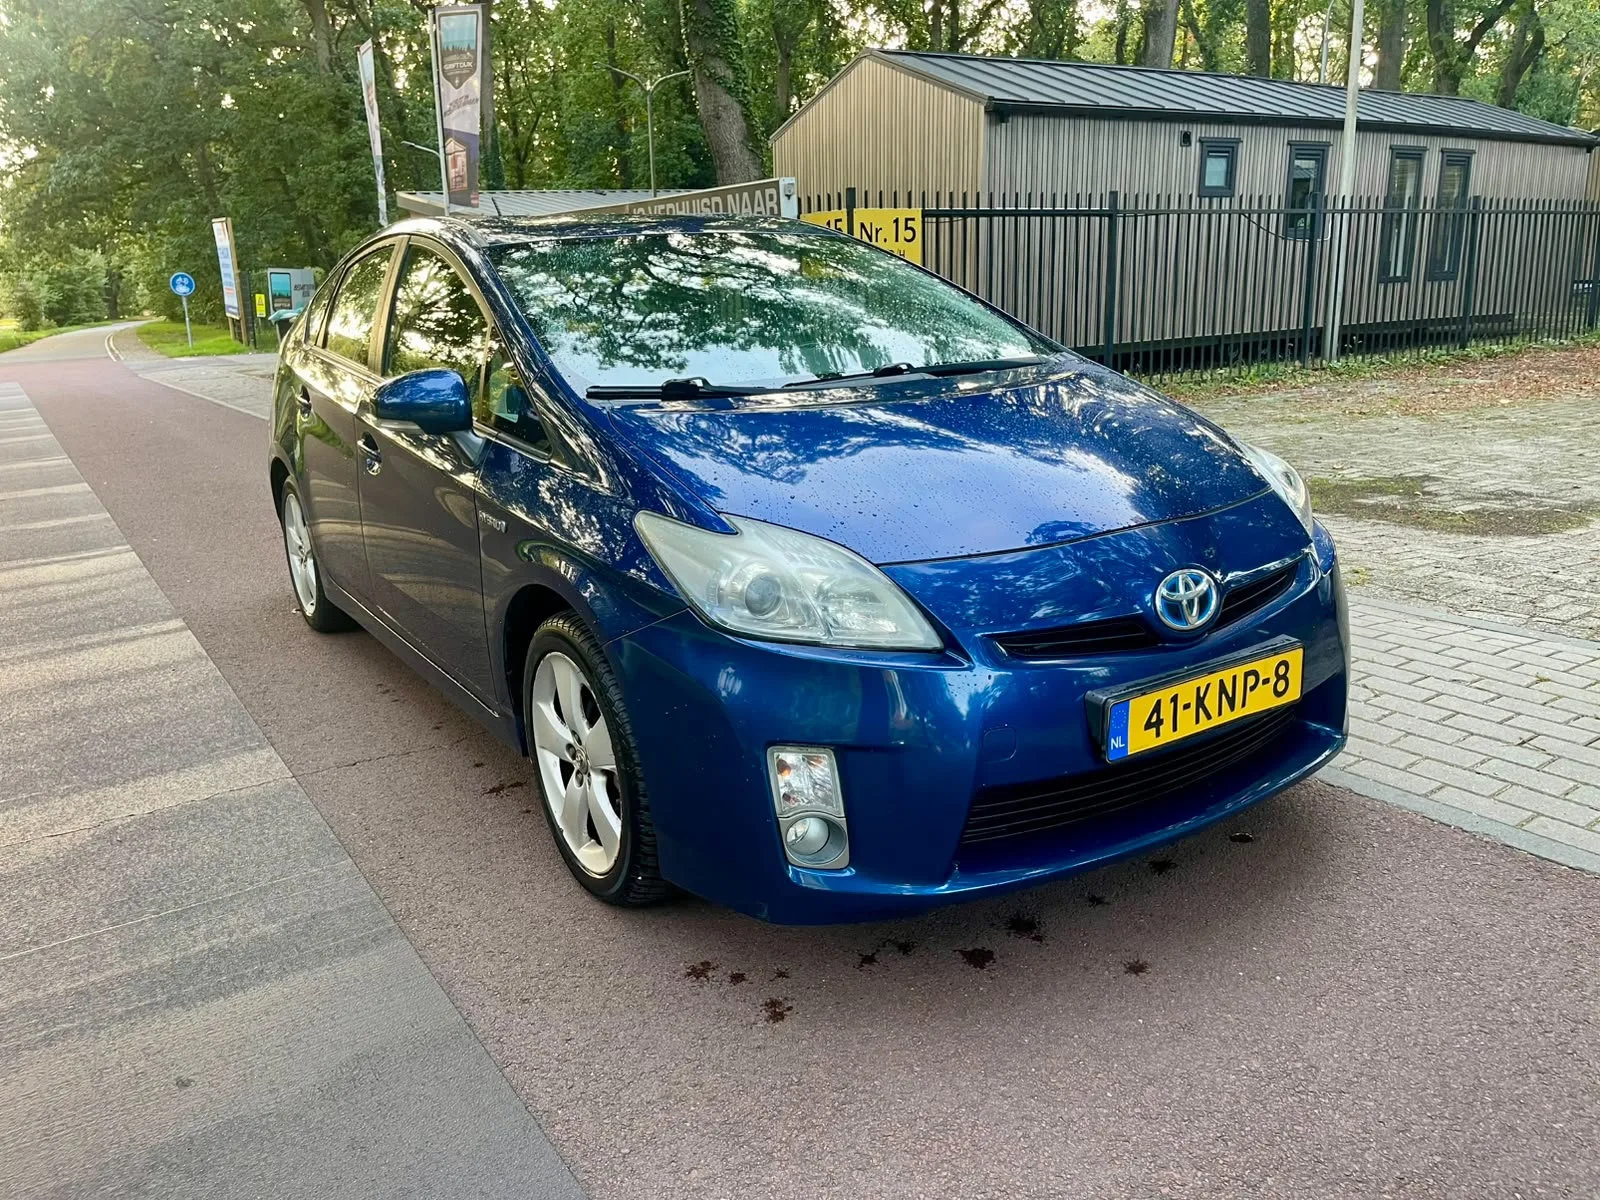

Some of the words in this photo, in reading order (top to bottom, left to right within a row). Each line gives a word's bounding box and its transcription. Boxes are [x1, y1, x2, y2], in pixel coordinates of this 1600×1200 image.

[727, 187, 778, 217] NAAR
[860, 221, 887, 243] Nr.
[893, 217, 917, 243] 15
[1143, 659, 1290, 738] 41-KNP-8
[1110, 735, 1125, 750] NL
